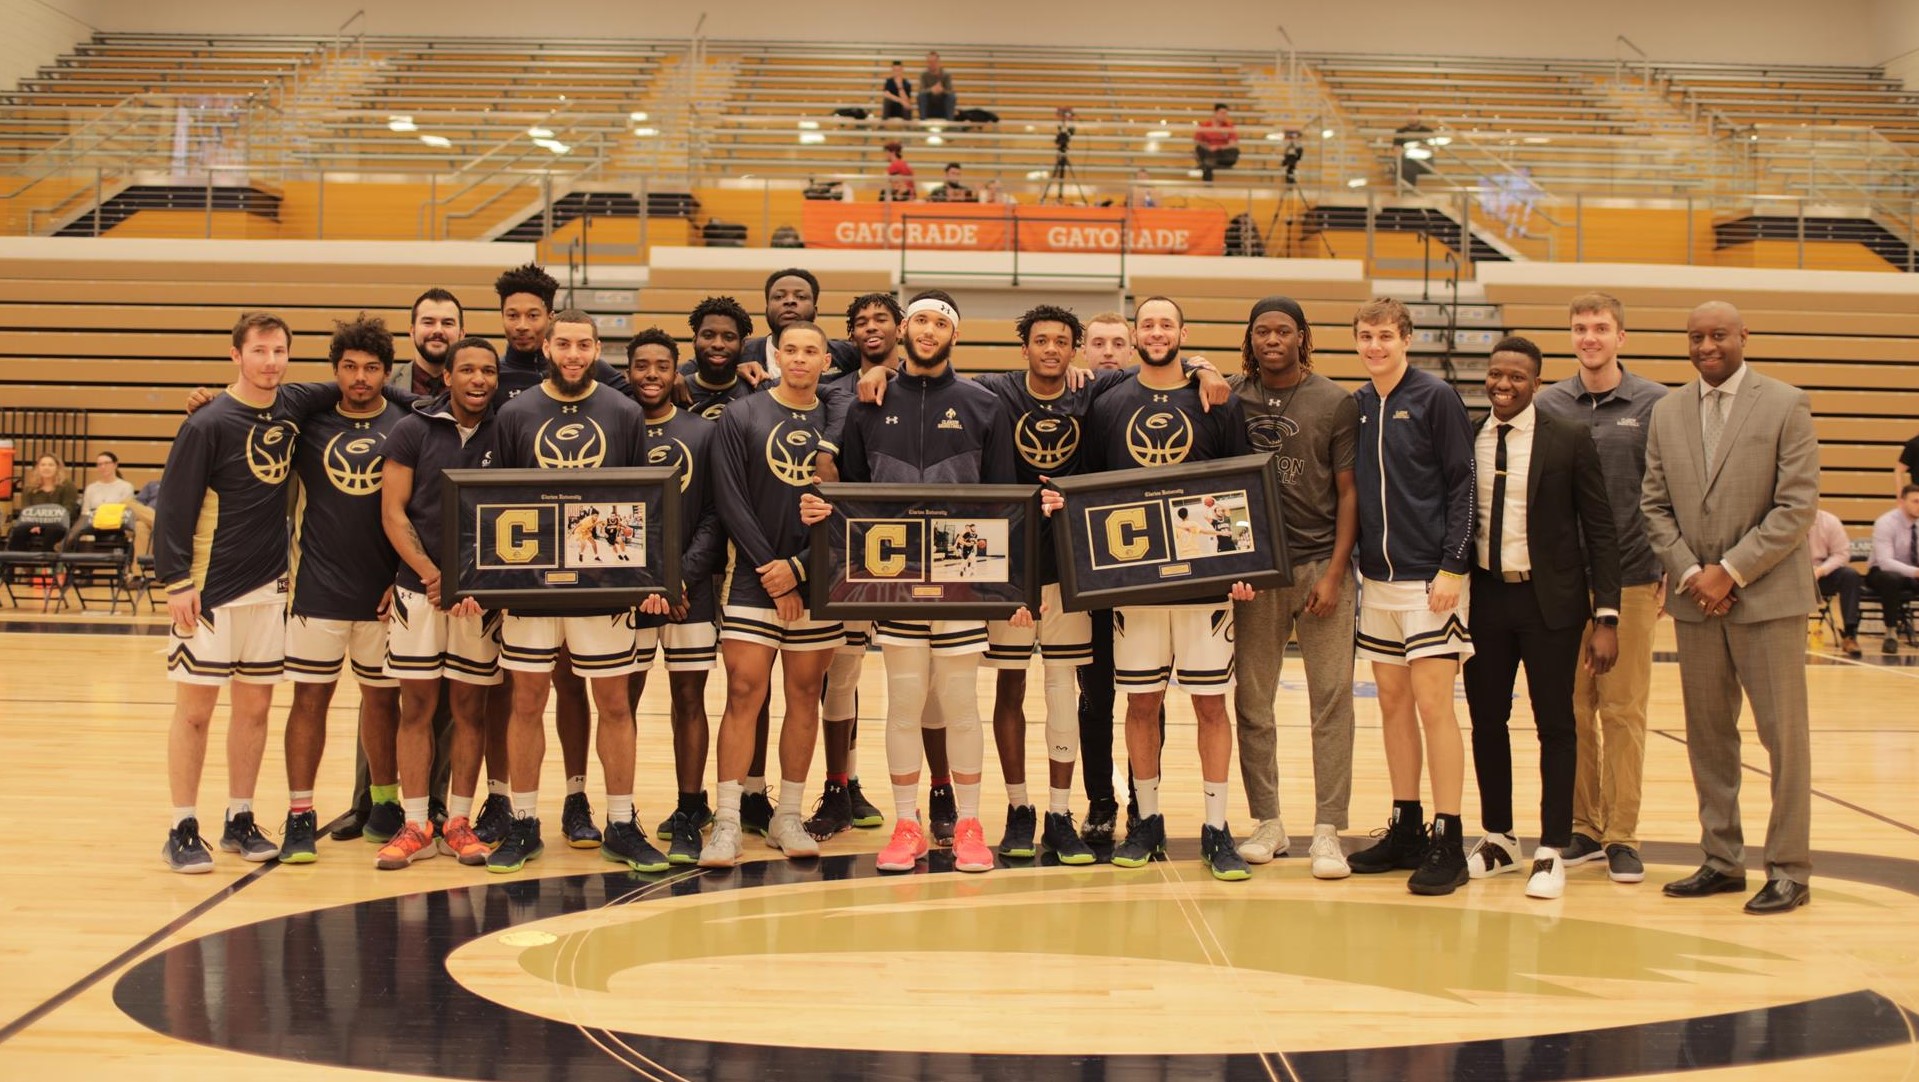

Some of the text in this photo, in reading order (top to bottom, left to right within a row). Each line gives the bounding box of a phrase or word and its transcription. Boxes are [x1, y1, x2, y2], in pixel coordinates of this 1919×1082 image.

[836, 221, 978, 245] GATORADE
[495, 509, 539, 563] C
[865, 524, 907, 577] C
[1105, 507, 1150, 562] C
